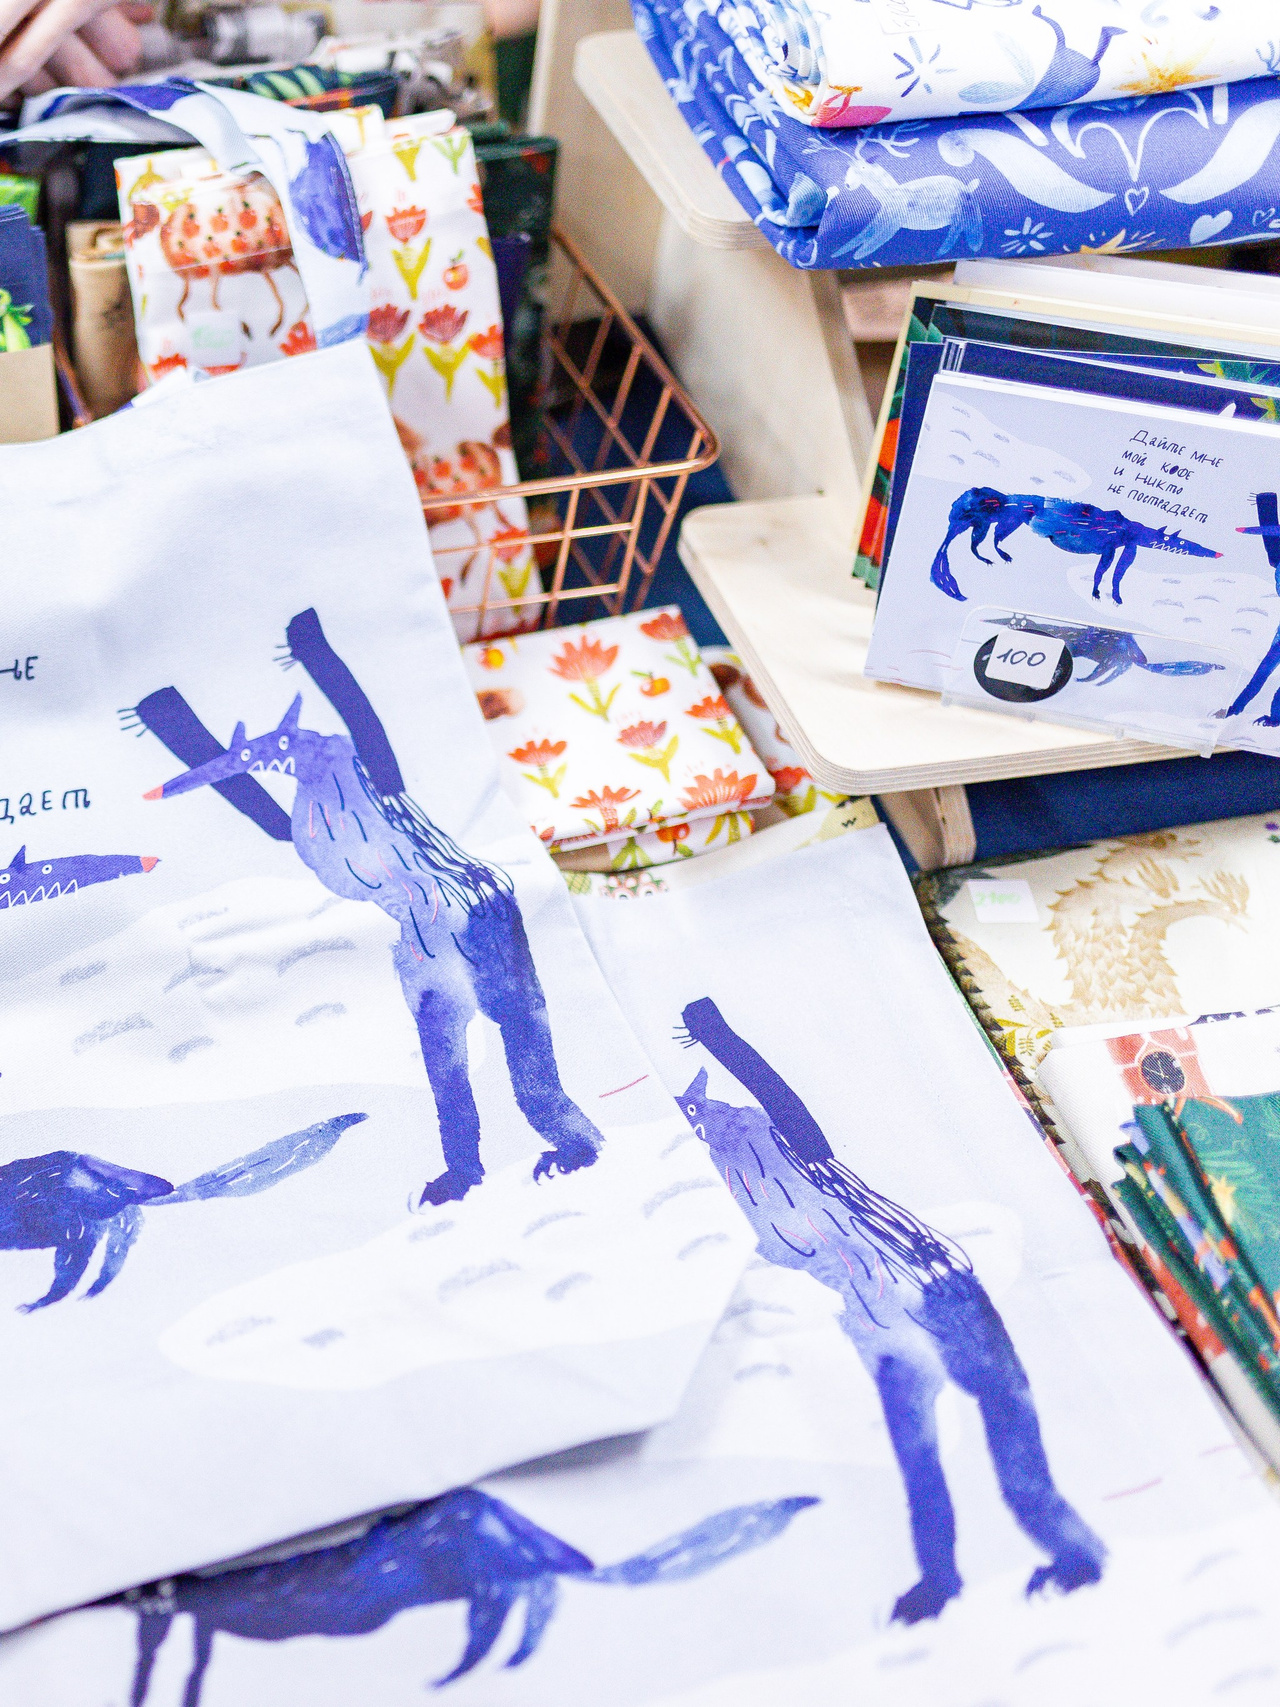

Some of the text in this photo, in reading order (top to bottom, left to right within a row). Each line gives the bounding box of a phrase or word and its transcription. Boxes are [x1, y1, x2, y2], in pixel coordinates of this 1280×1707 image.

[1129, 429, 1187, 456] Дайте
[1121, 449, 1195, 480] мой кофе
[1113, 466, 1184, 495] и никто
[1107, 483, 1209, 524] не пострадает
[996, 648, 1046, 667] 100
